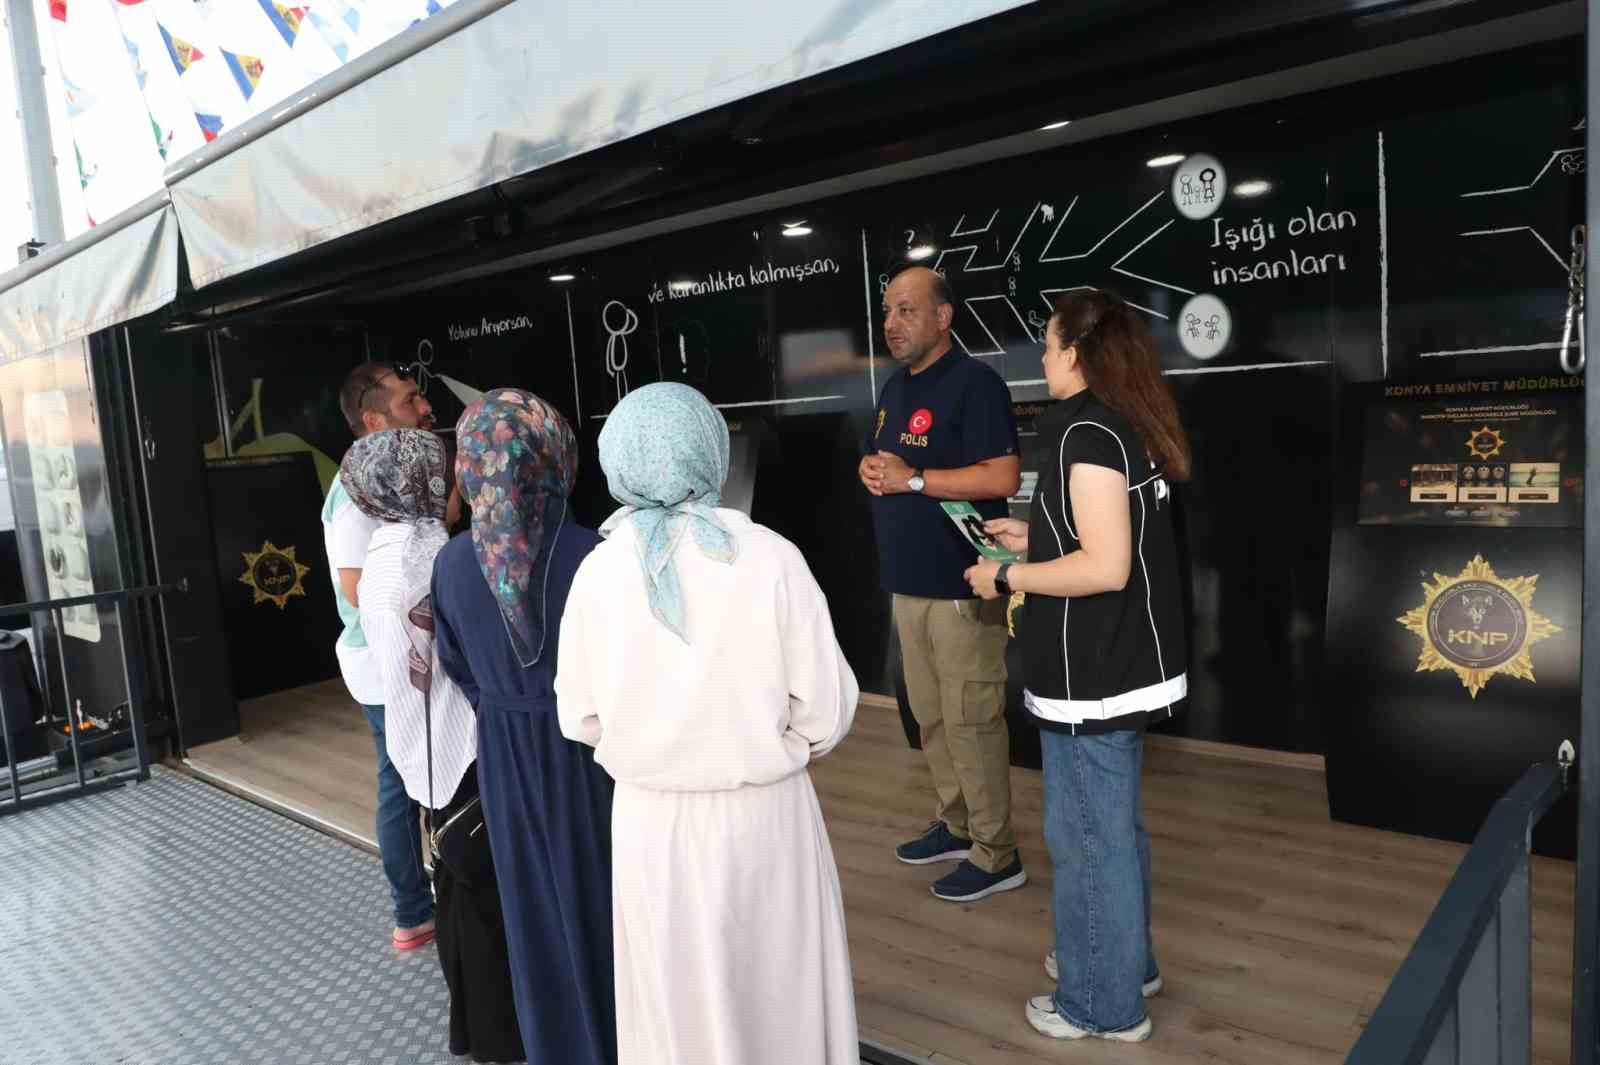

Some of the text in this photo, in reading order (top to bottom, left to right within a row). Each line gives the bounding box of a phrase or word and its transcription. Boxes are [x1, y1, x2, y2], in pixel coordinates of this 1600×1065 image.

[1210, 205, 1356, 251] Işığı olan
[669, 271, 745, 299] karanlıkta
[750, 258, 840, 286] kalmışsan,
[1211, 249, 1346, 285] insanları
[1385, 386, 1432, 397] KONYA
[1448, 629, 1508, 645] KNP
